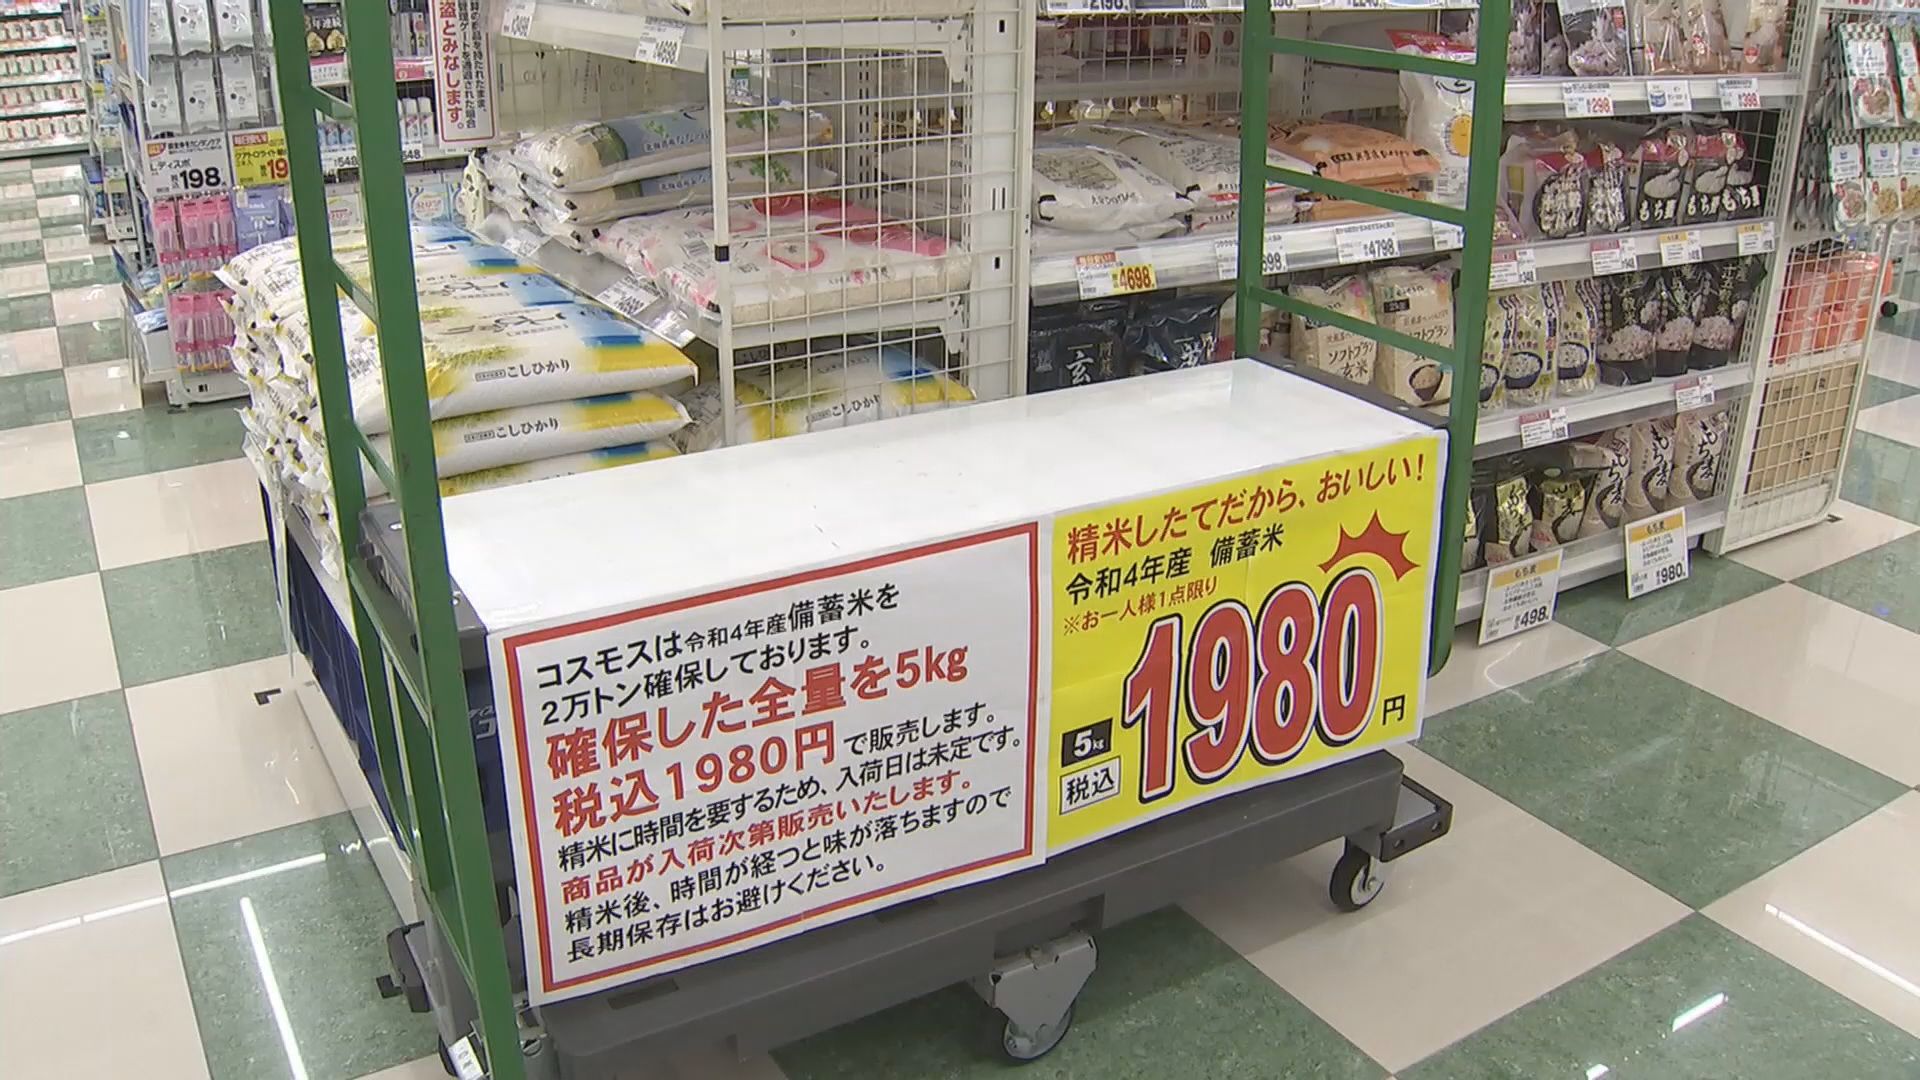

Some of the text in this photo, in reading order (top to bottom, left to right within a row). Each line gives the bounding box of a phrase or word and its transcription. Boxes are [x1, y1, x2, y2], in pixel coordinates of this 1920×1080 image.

[179, 166, 221, 190] 198
[1120, 266, 1152, 291] 4698
[507, 358, 570, 379] こしひかり
[1328, 341, 1374, 365] ソフトブラン
[495, 417, 560, 439] こしひかり
[832, 394, 881, 418] こしひかり
[1067, 453, 1425, 565] 精米したてだから、おいしい!
[1065, 523, 1285, 606] 令和4年産 備蓄米
[1661, 562, 1683, 584] 980
[536, 582, 900, 690] コスモスは令和4年産備蓄米を
[1520, 605, 1547, 627] 498
[541, 626, 872, 726] 2万トン確保しております。
[545, 643, 969, 781] 確保した全量を5kg
[558, 727, 1021, 873] 精米に時間を要するため、入荷日は未定です。
[1066, 767, 1115, 805] 税込
[560, 769, 972, 905] 商品が入荷次第販売いたします。
[565, 786, 1012, 935] 精米後、時間が経つと味が落ちますので
[567, 860, 885, 964] 長期保存はお避けください。
